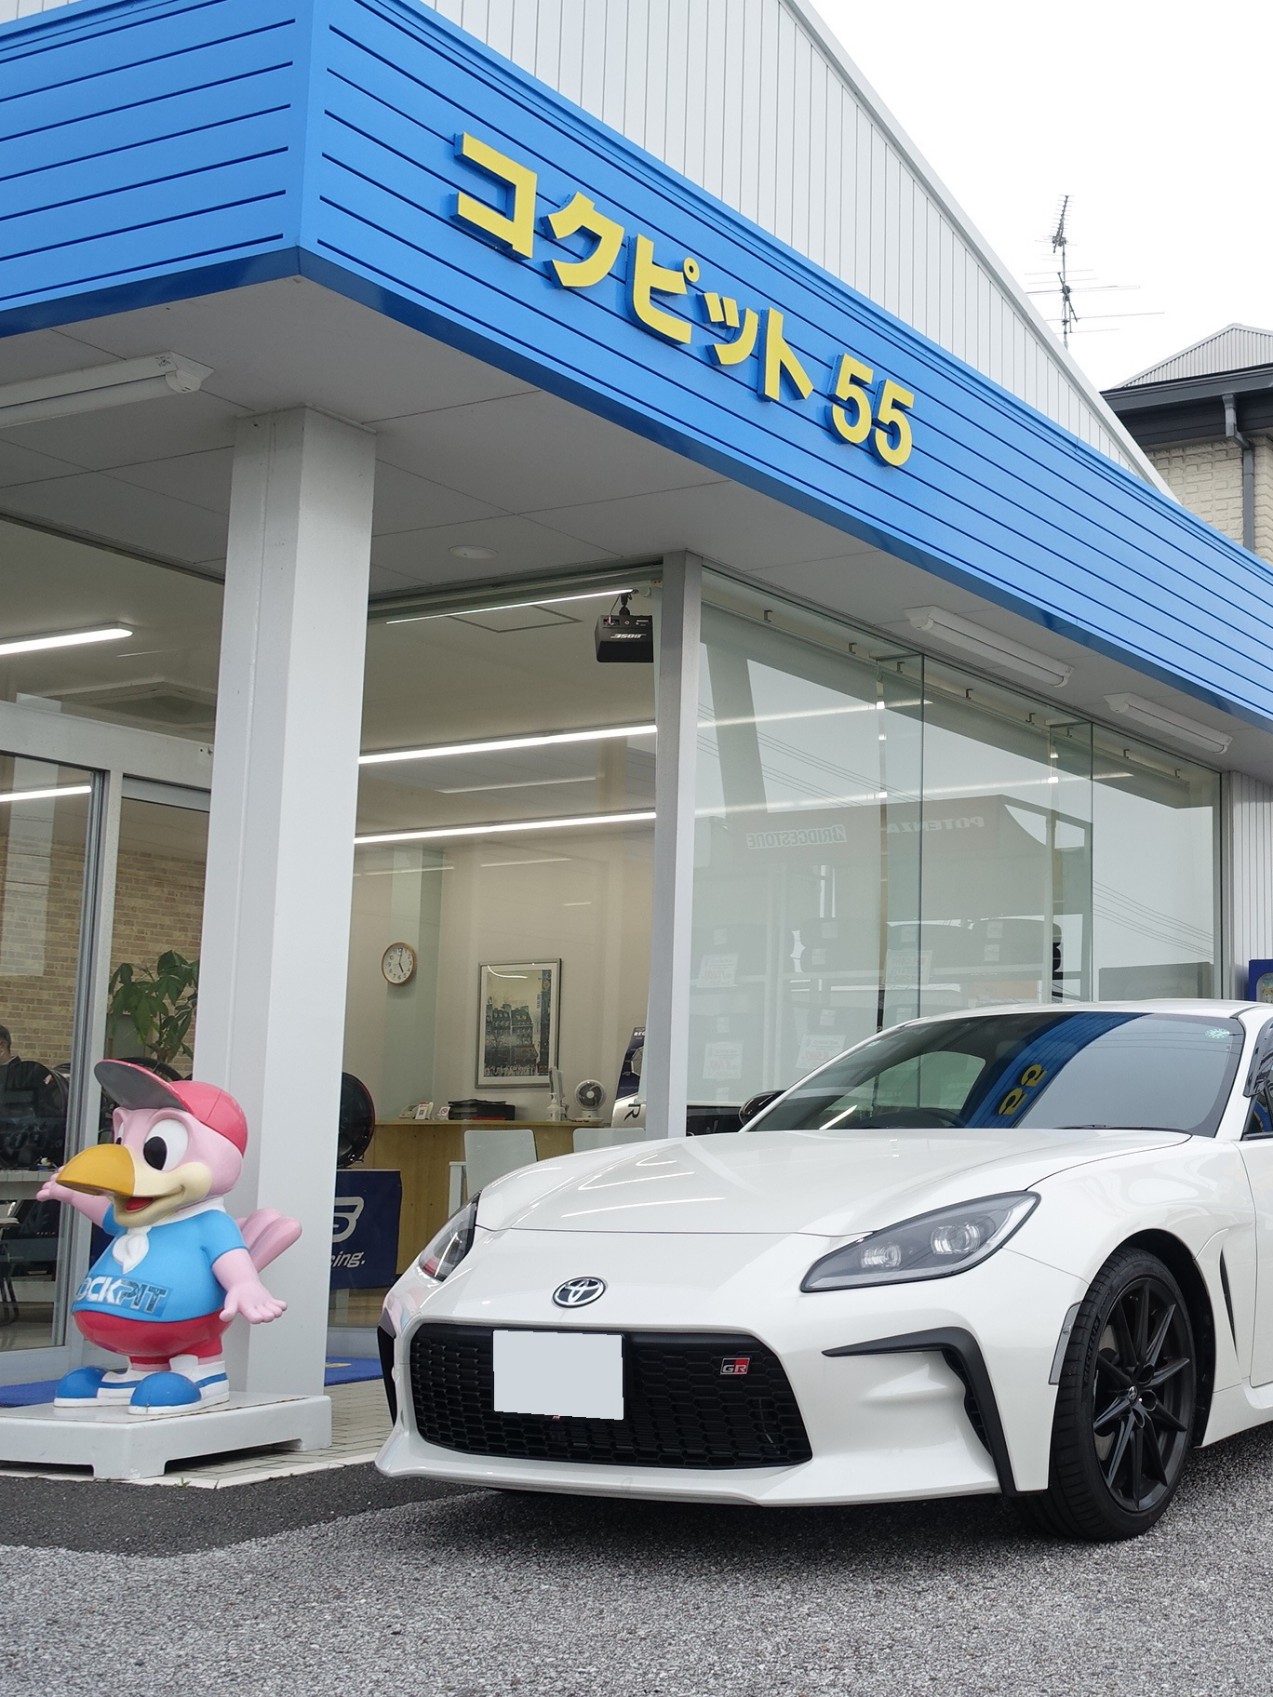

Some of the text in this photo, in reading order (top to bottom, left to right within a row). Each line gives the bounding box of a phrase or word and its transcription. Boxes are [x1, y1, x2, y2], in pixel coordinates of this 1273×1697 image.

[453, 131, 915, 467] コクピット 55
[722, 1364, 747, 1373] GR
